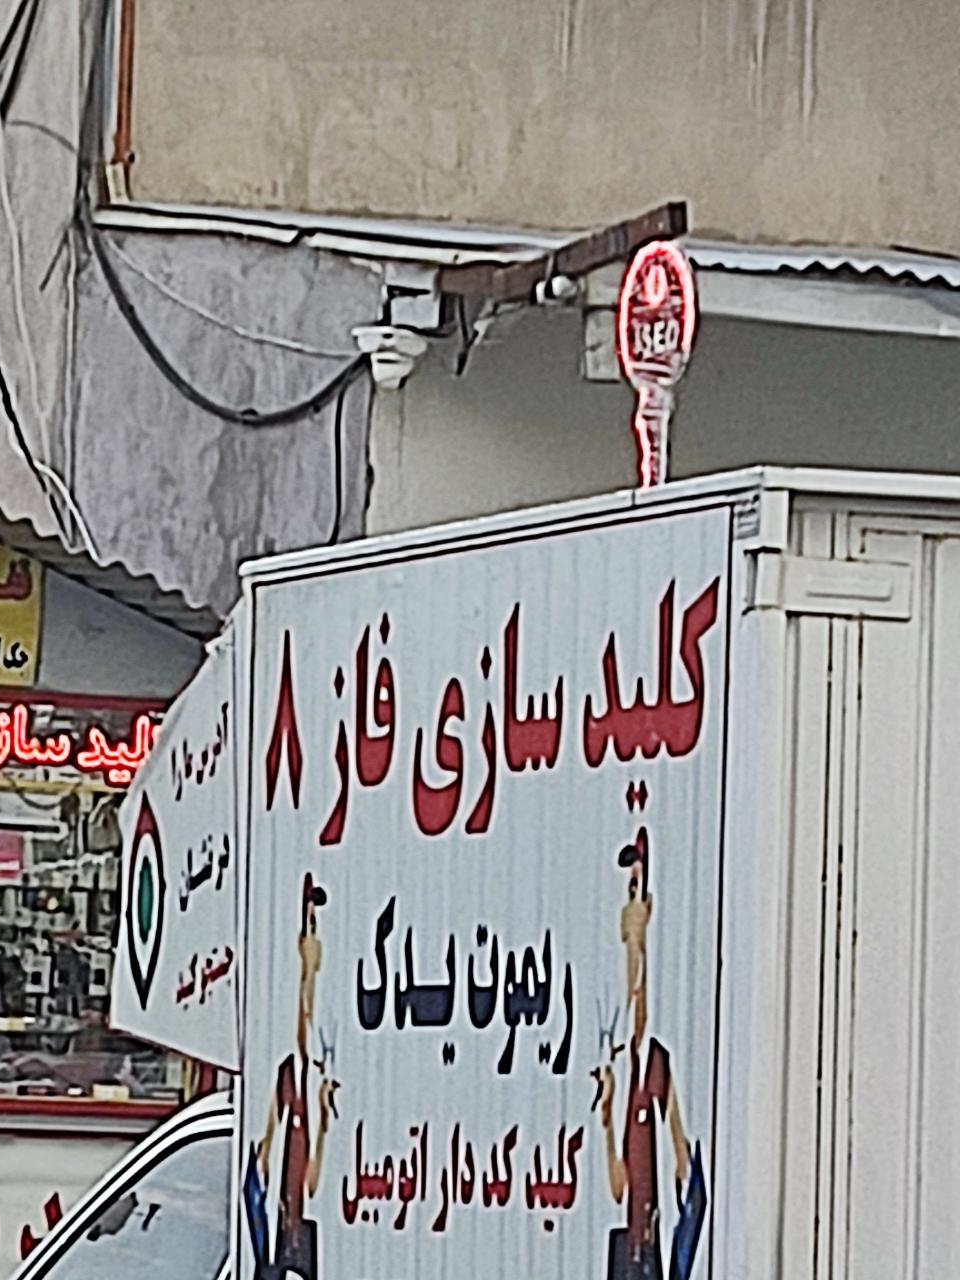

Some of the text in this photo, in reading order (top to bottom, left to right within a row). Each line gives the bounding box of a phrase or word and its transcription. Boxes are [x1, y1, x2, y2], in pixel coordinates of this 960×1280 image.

[77, 714, 162, 783] لید
[265, 629, 303, 812] ۸
[319, 612, 396, 846] فاز
[412, 602, 564, 836] سازی
[583, 576, 721, 814] کلید
[357, 896, 455, 1066] یدک
[468, 924, 574, 1074] ریموت
[342, 1119, 429, 1231] اتومبیل
[526, 1123, 584, 1232] کلید
